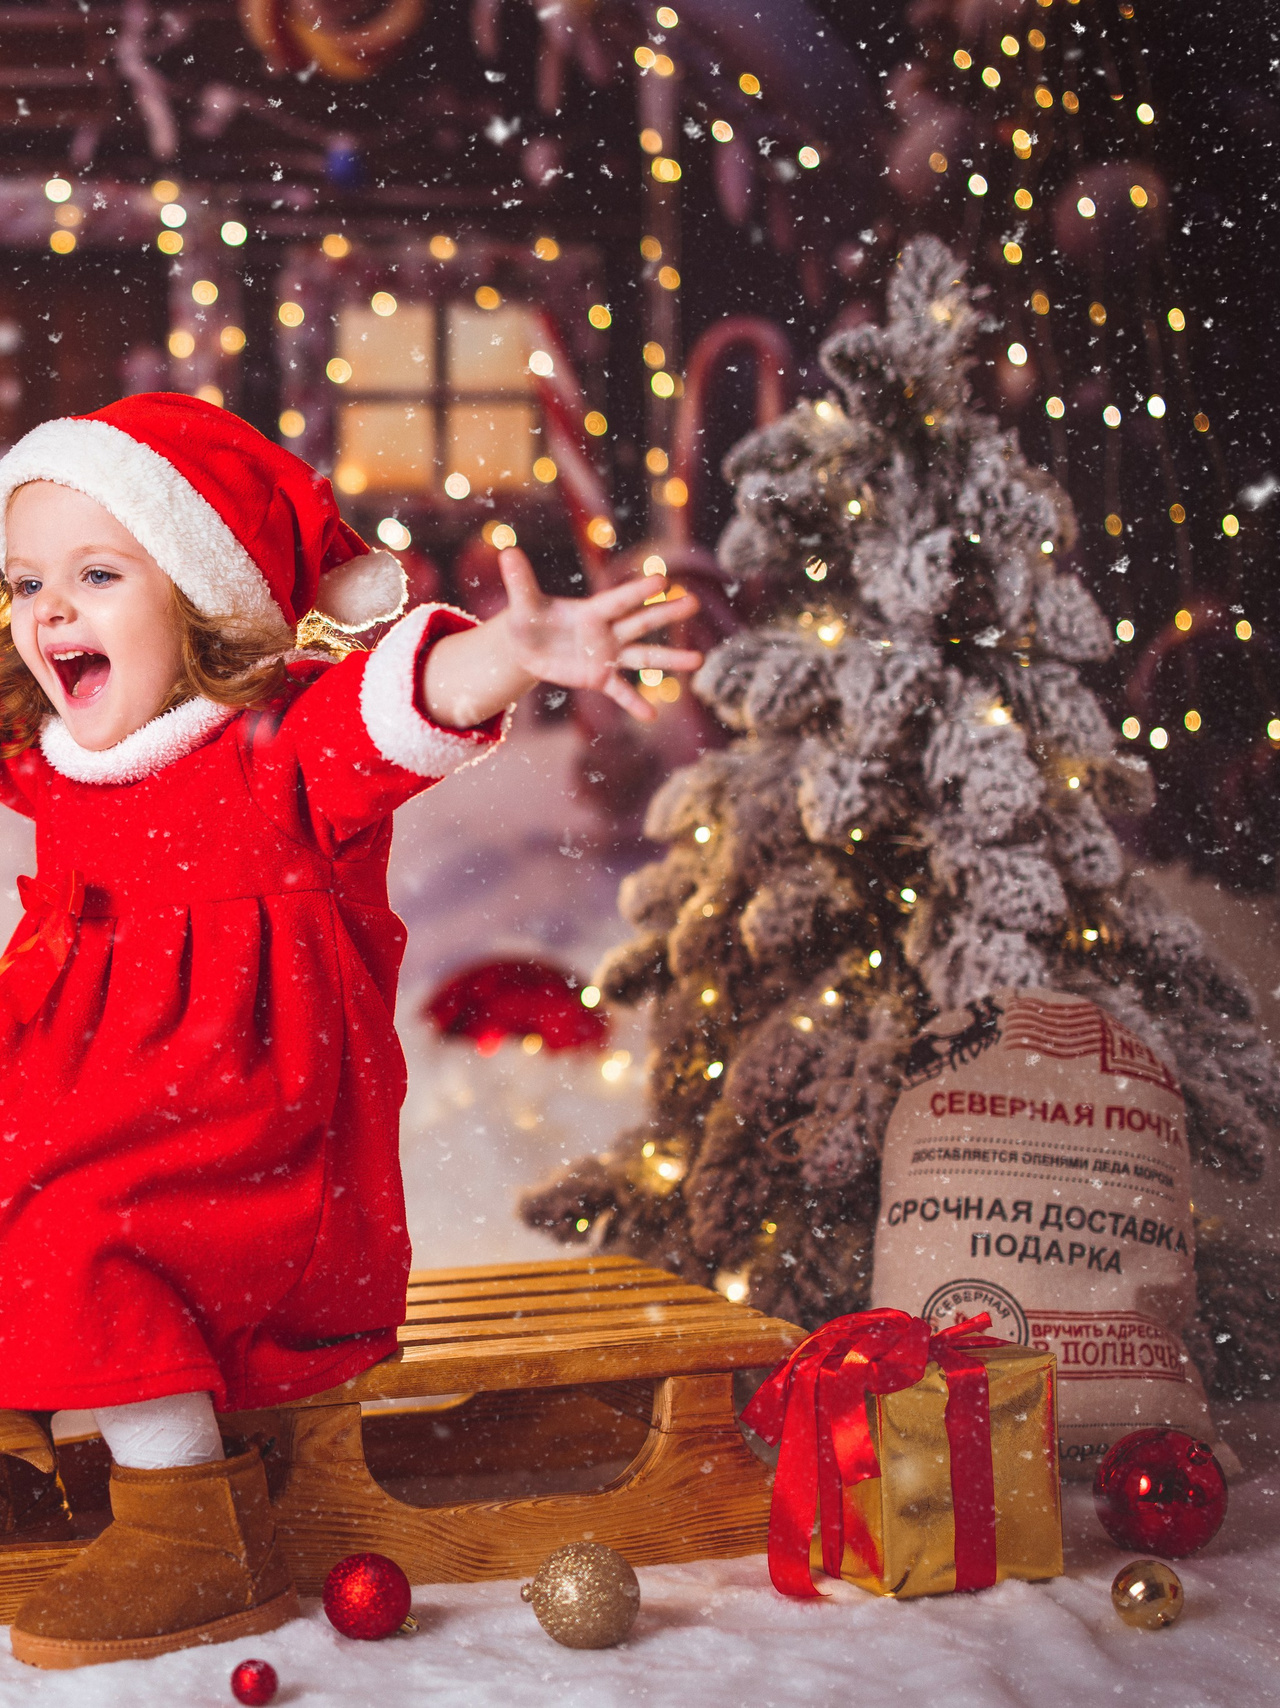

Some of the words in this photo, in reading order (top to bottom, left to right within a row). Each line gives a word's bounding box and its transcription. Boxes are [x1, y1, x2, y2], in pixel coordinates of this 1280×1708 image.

[930, 1090, 1094, 1127] СЕВЕРНАЯ
[912, 1147, 1018, 1163] ДОСТАВЛЯЕТСЯ
[1021, 1151, 1089, 1170] ОЛЕНЯМИ
[1091, 1158, 1130, 1175] ДЕДА
[888, 1197, 1032, 1226] СРОЧНАЯ
[1040, 1203, 1188, 1256] ДОСТАВКА
[971, 1233, 1122, 1275] ПОДАРКА
[935, 1290, 1010, 1319] СЕВЕРНАЯ
[1032, 1324, 1103, 1339] ВРУЧИТЬ
[1061, 1341, 1179, 1370] ПОЛНОЧЬ
